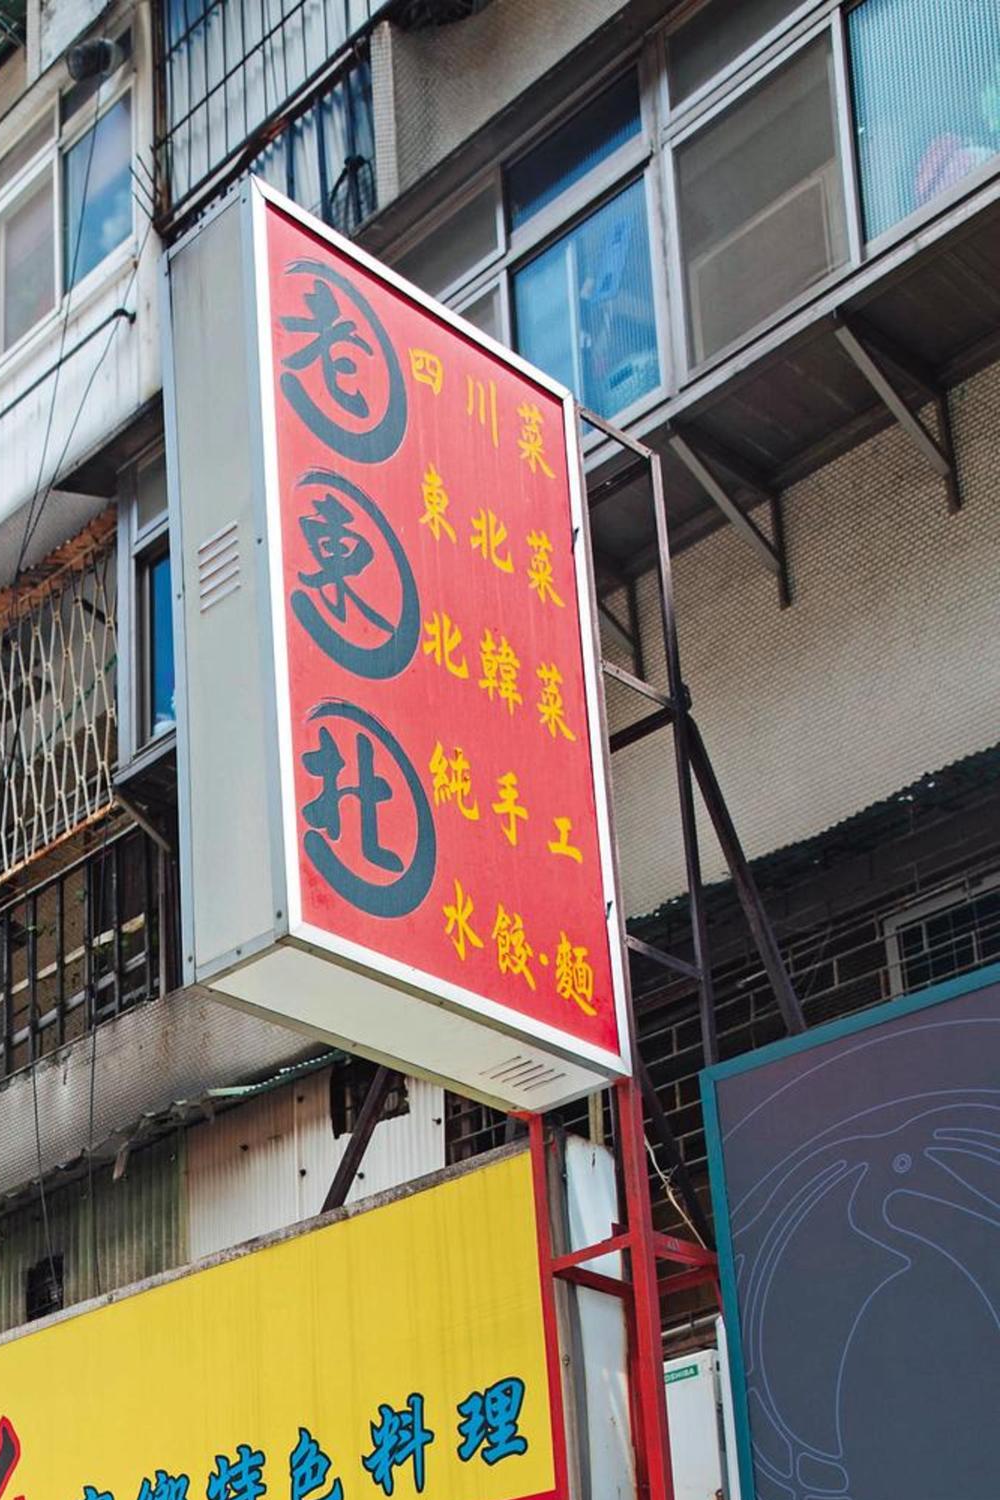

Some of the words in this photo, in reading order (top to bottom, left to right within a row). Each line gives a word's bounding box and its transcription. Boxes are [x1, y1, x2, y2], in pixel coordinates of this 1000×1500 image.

[408, 345, 557, 481] 四川菜
[278, 275, 407, 875] 老東北
[419, 464, 566, 609] 東北菜
[422, 609, 577, 743] 北韓菜
[432, 741, 584, 865] 純手工
